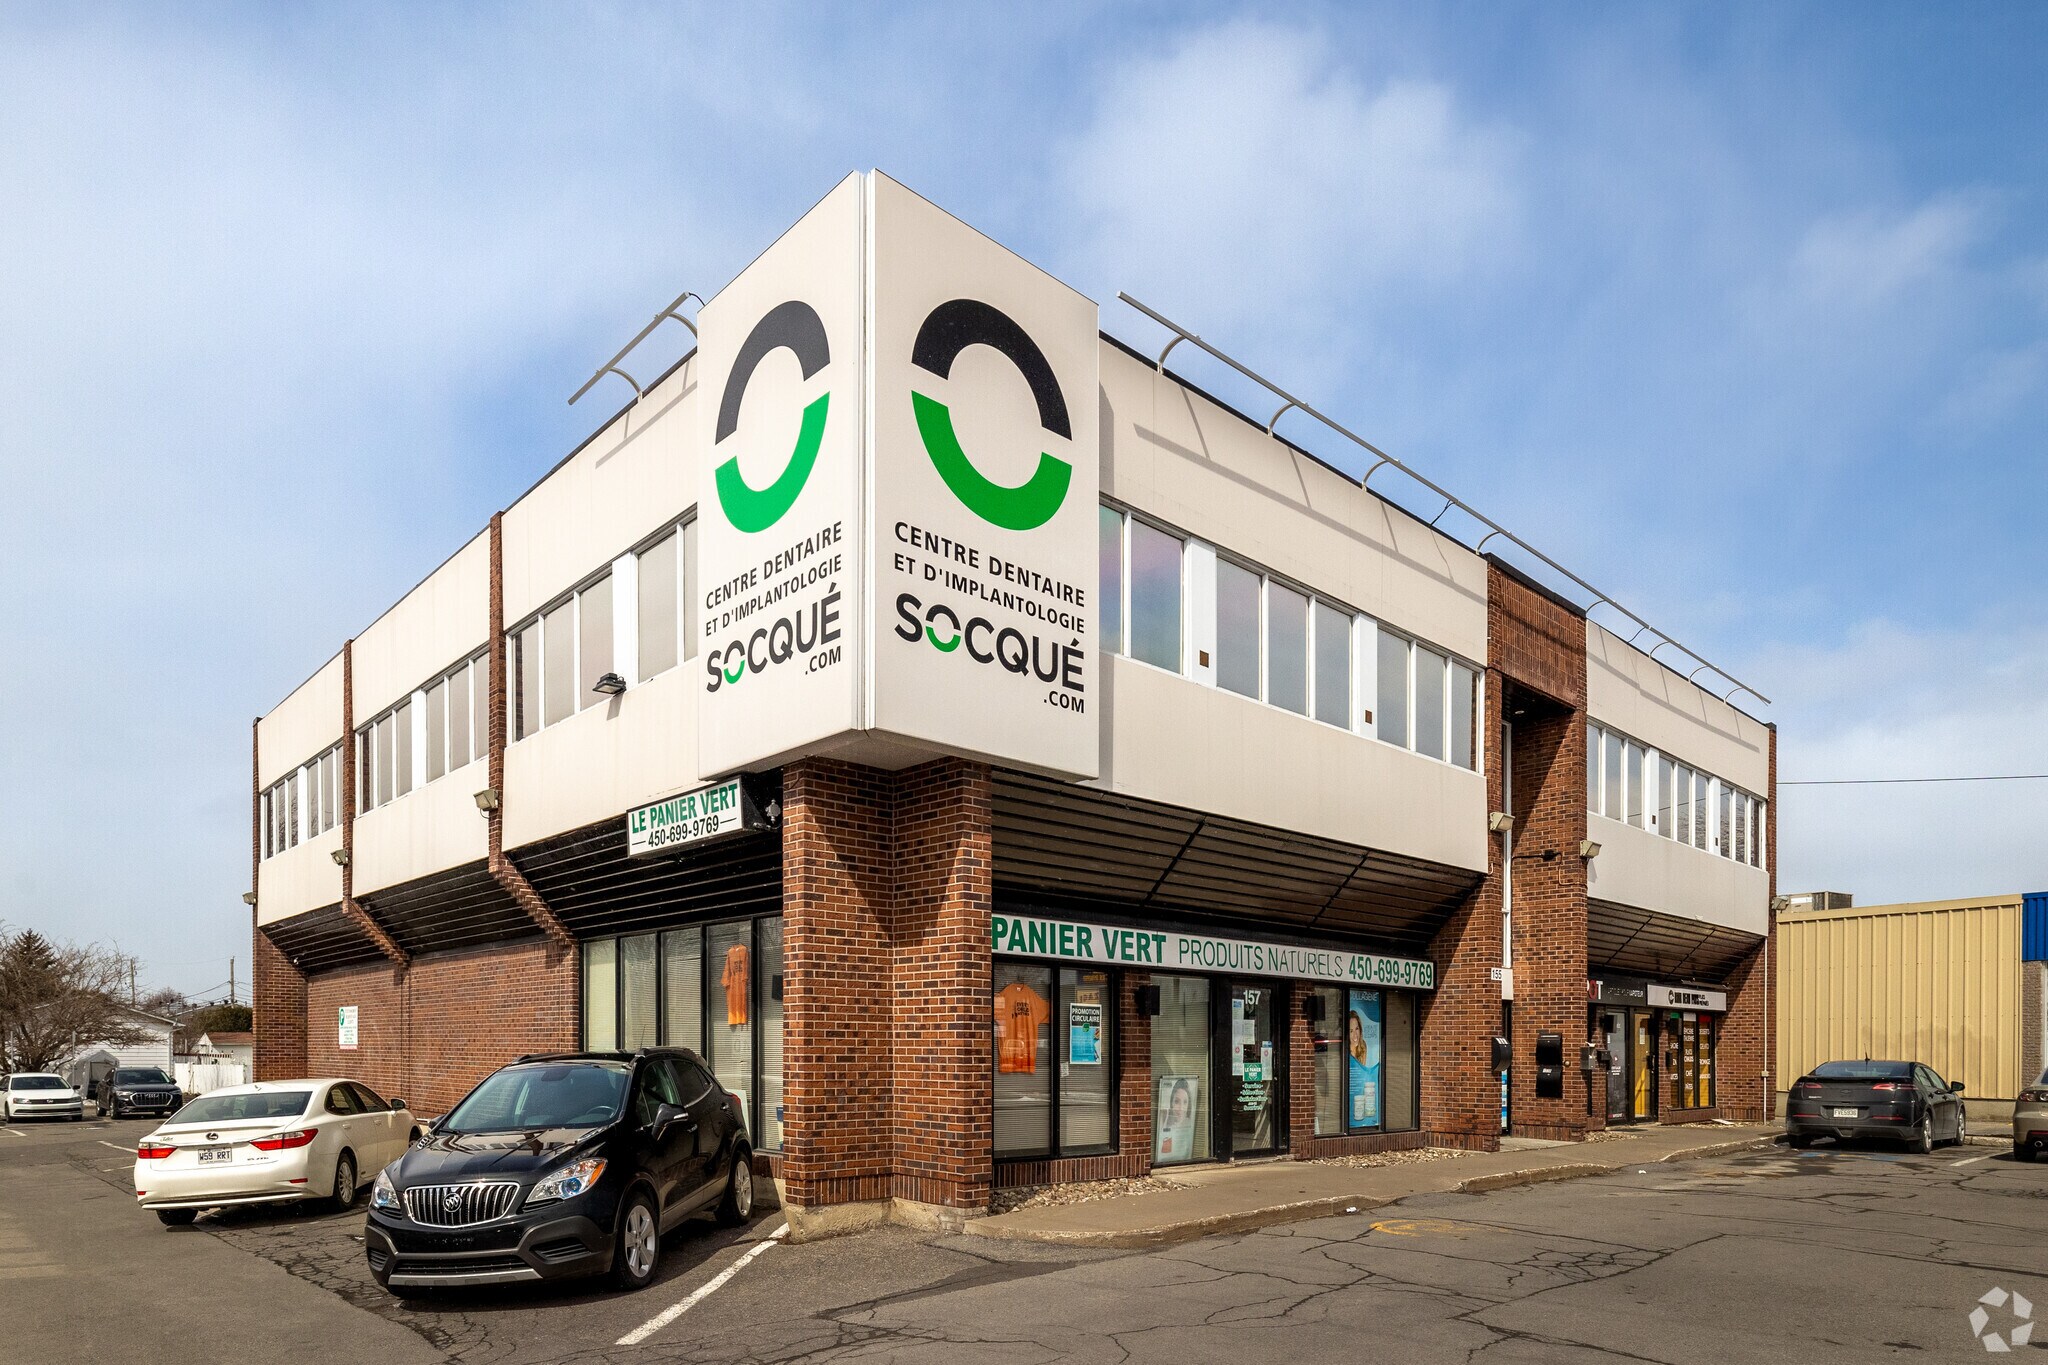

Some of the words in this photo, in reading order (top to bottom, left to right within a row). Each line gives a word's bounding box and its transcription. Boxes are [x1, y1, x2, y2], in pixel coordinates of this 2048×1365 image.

[706, 567, 757, 610] CENTRE
[764, 521, 842, 580] DENTAIRE
[894, 521, 979, 569] CENTRE
[989, 555, 1085, 608] DENTAIRE
[706, 616, 717, 637] ET
[722, 554, 842, 626] D'IMPLANTOLOGIE
[894, 552, 916, 575] ET
[924, 565, 1085, 634] D'IMPLANTOLOGIE
[706, 581, 842, 692] SOCQUÉ
[894, 592, 1085, 692] SOCQUÉ
[805, 645, 842, 675] .COM
[1043, 690, 1085, 714] .COM
[632, 810, 647, 834] LE
[650, 796, 697, 830] PANIER
[700, 783, 738, 816] VERT
[648, 814, 719, 847] 450-699-9769
[992, 914, 1093, 960] PANIER
[1100, 928, 1167, 964] VERT
[1178, 938, 1264, 970] PRODUITS
[1268, 949, 1343, 978] NATURELS
[1349, 954, 1434, 989] 450-699-9769
[1492, 969, 1502, 980] 155
[1072, 1007, 1100, 1016] PROMOTION
[1243, 990, 1261, 1005] 157
[1072, 1015, 1100, 1023] CIRCULAIRE
[199, 1152, 213, 1162] W59
[217, 1150, 231, 1161] RRT
